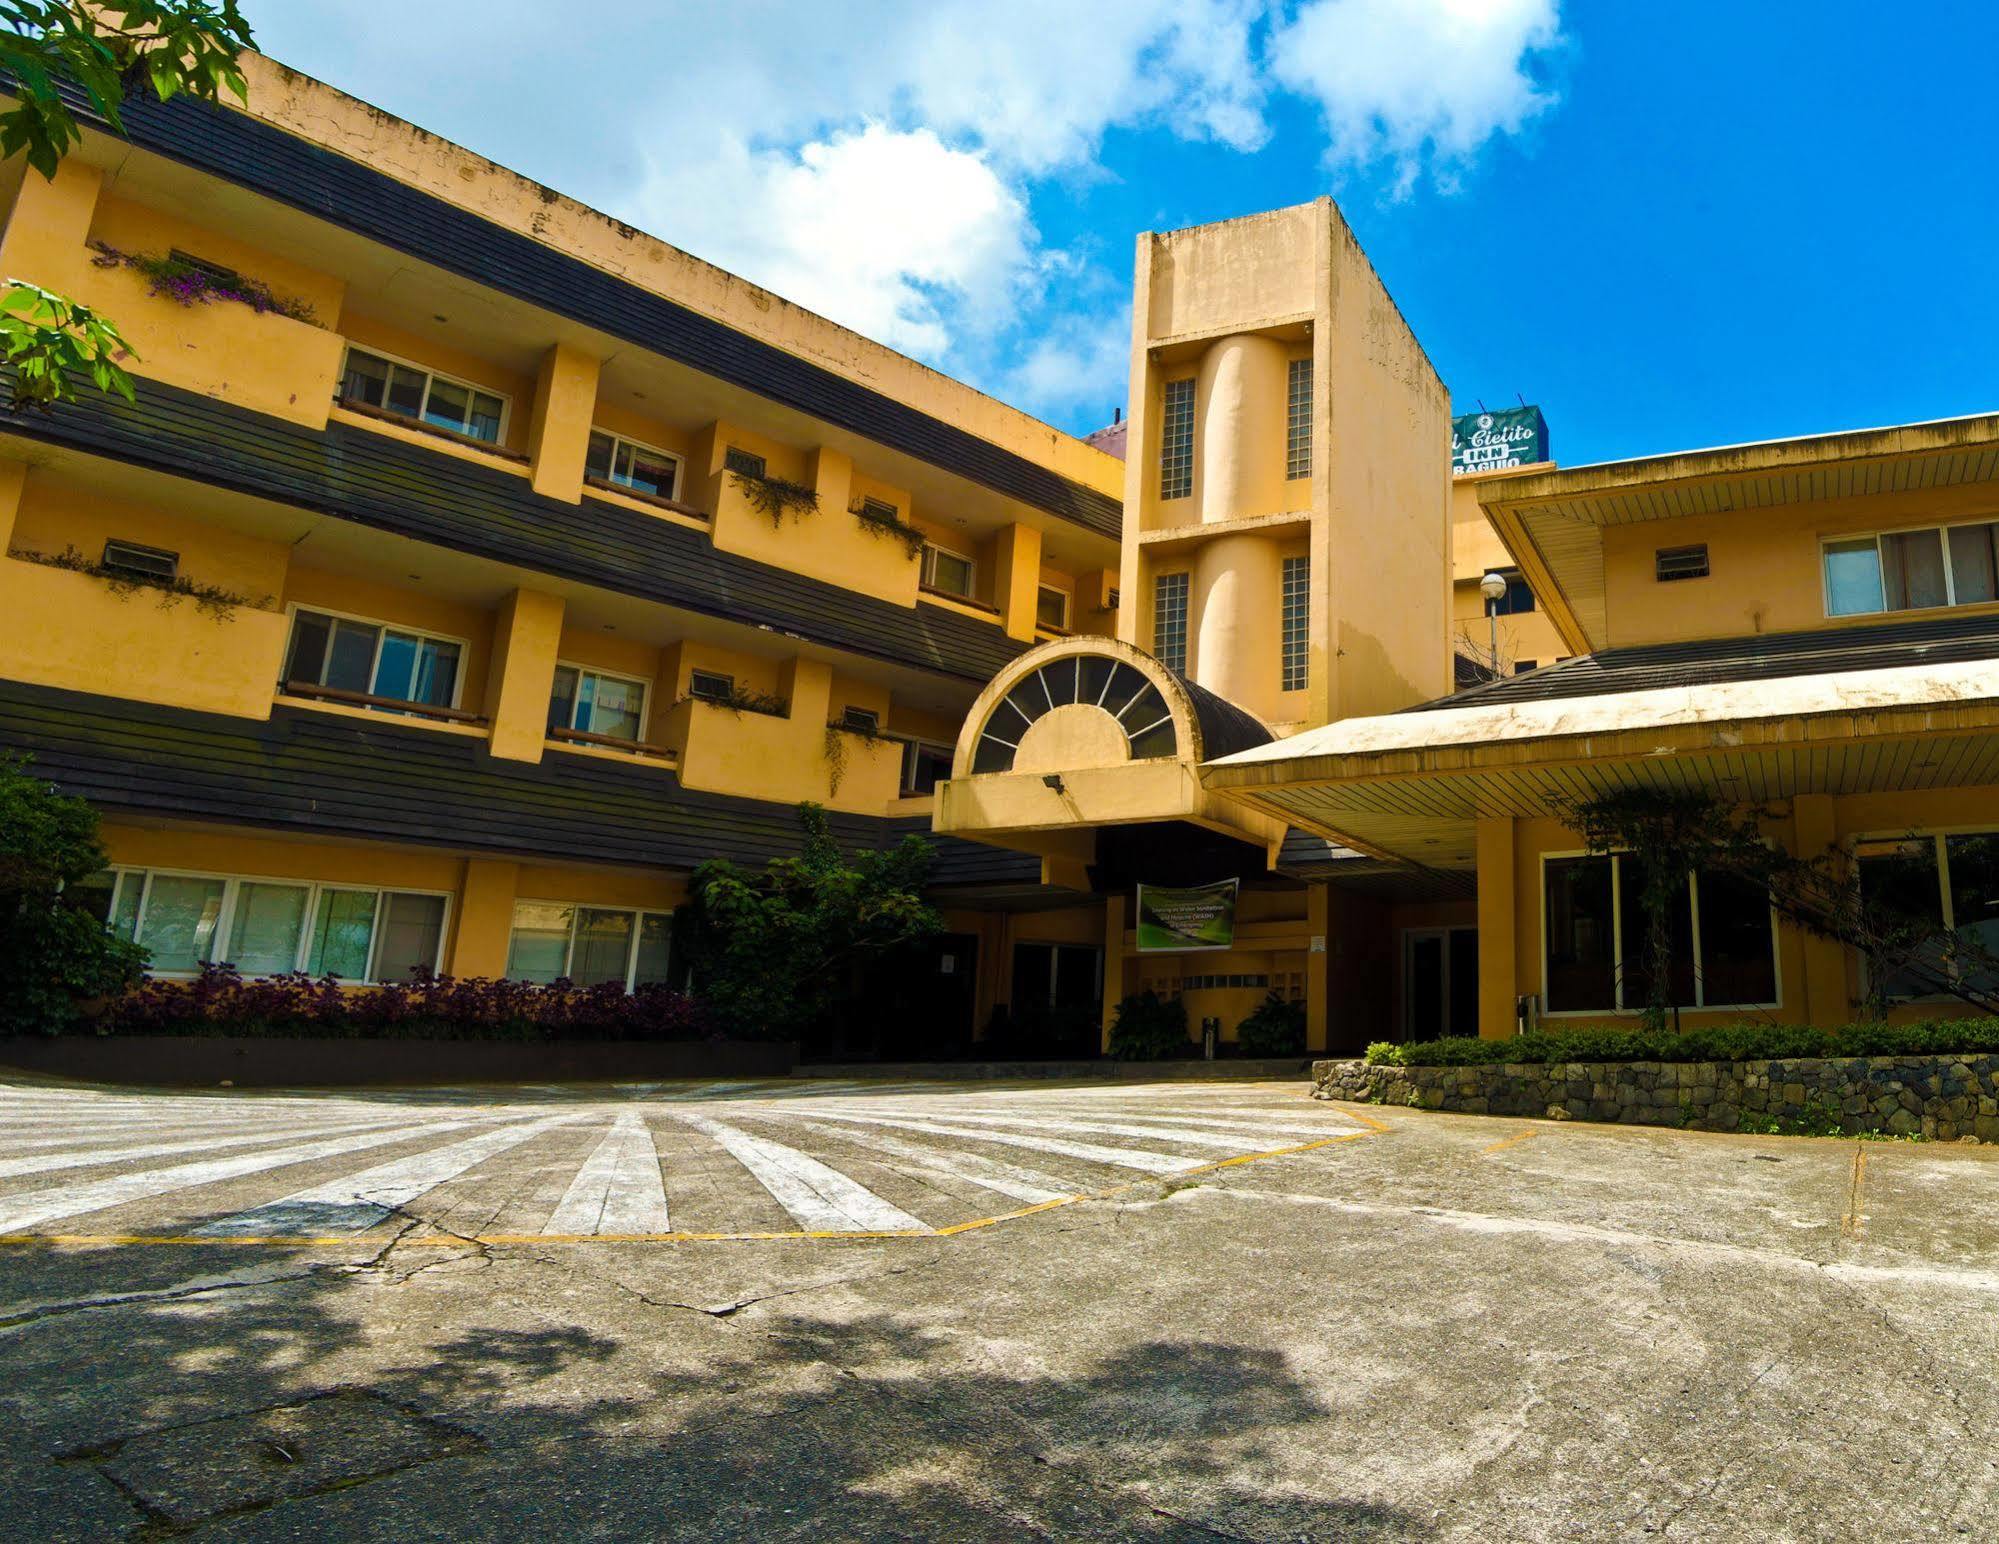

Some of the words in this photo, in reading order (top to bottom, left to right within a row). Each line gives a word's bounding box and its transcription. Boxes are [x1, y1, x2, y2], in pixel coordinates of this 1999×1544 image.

[1468, 425, 1535, 447] Cielito
[1469, 448, 1502, 461] INN
[1453, 457, 1520, 475] BAGUIO
